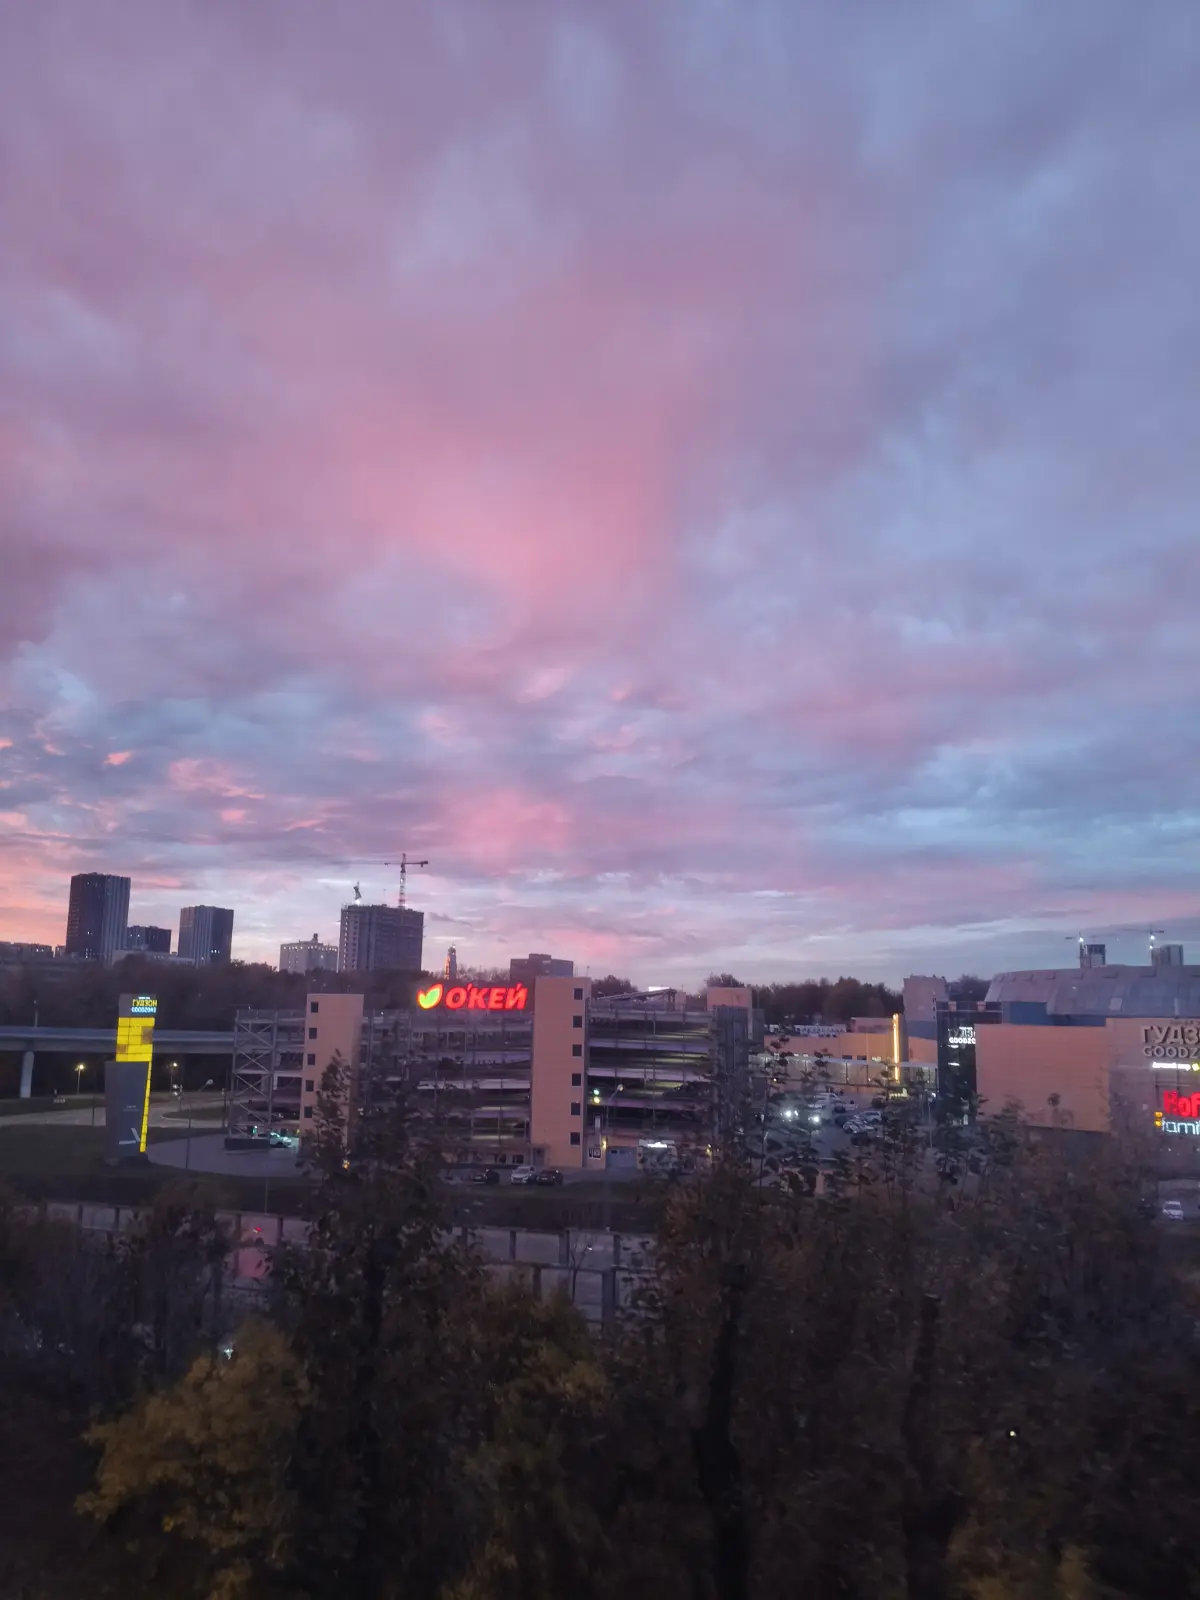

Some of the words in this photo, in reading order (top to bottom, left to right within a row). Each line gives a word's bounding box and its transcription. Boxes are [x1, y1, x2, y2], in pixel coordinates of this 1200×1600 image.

[132, 999, 157, 1007] ГУДЗОН
[445, 982, 528, 1010] О'КЕЙ
[948, 1028, 976, 1038] ГУДЗ
[1142, 1025, 1200, 1045] ГУДЗ
[1161, 1117, 1200, 1135] fami
